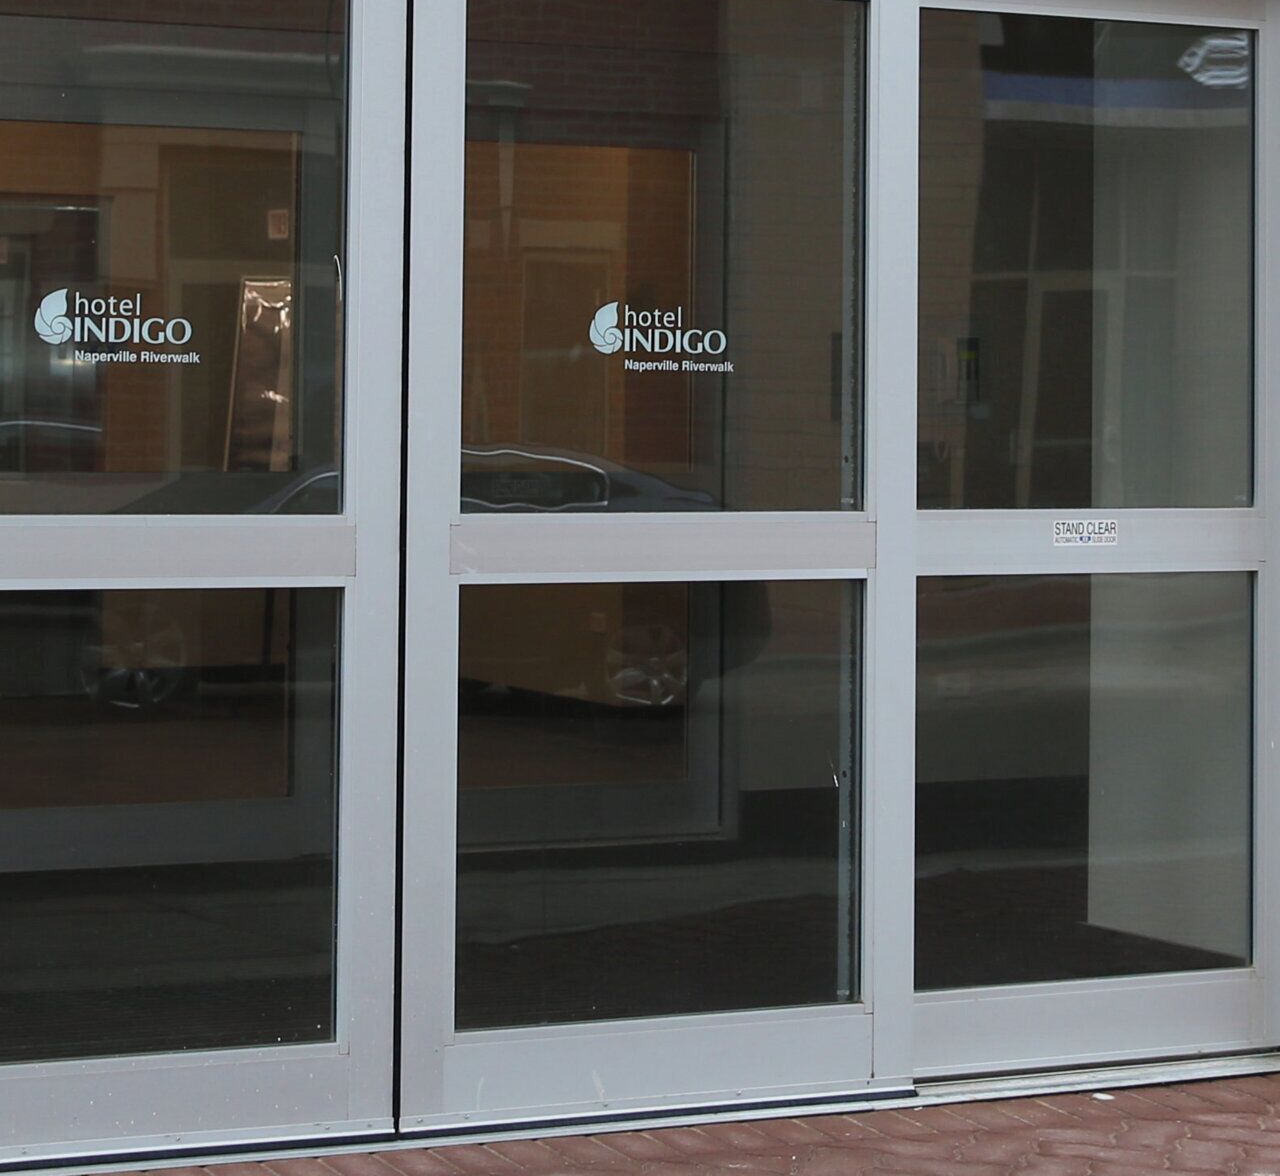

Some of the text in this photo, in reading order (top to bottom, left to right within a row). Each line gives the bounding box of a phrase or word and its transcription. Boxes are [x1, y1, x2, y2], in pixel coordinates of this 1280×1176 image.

[75, 291, 141, 316] hotel
[625, 304, 682, 328] hotel
[74, 317, 192, 345] INDIGO
[624, 328, 727, 355] INDIGO
[75, 350, 200, 364] Naperville Riverwalk
[625, 359, 734, 373] Naperville Riverwalk
[1055, 522, 1116, 535] STAND CLEAR
